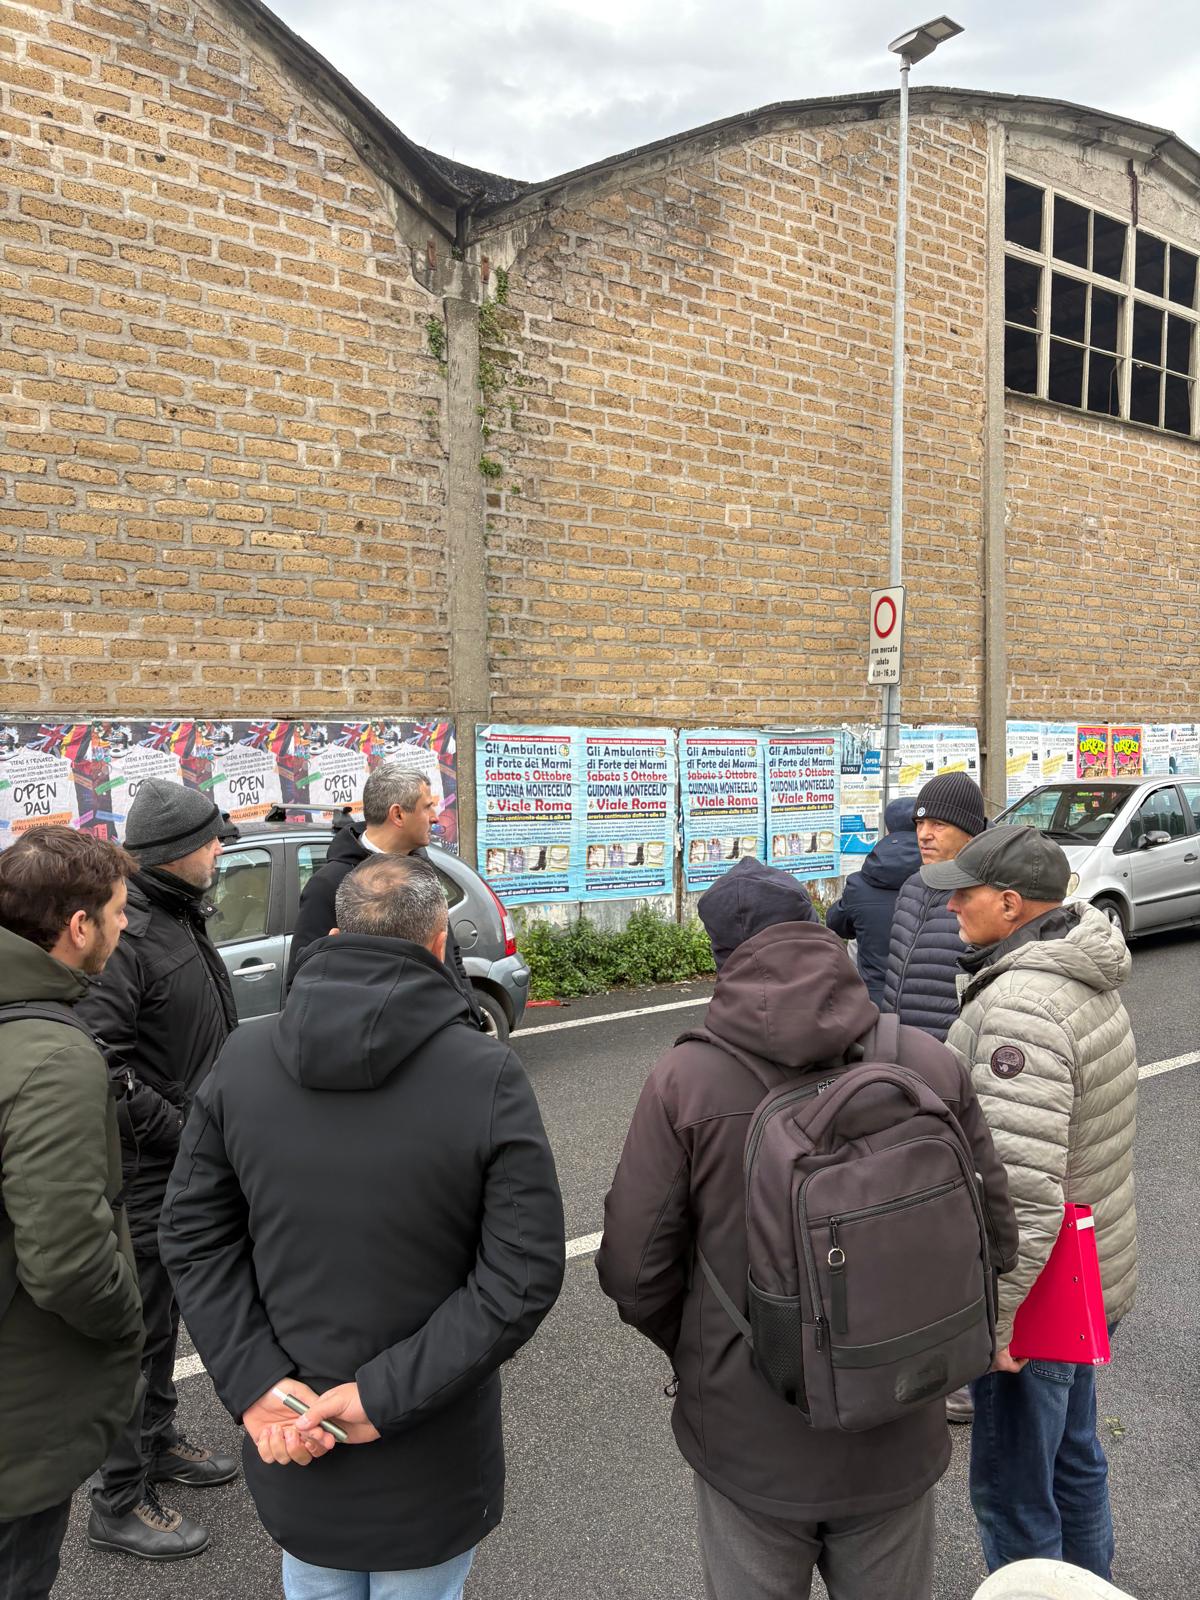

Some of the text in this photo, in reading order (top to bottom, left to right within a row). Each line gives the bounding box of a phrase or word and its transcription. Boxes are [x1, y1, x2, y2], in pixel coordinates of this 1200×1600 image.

[880, 645, 898, 653] mercato
[485, 743, 557, 755] Gli Ambulanti
[587, 746, 654, 756] Gli Ambulanti
[687, 747, 746, 756] Gli Ambulanti
[769, 746, 824, 755] Gli Ambulanti
[485, 757, 571, 768] di Forte dei Marmi
[587, 759, 667, 769] di Forte dei Marmi
[687, 759, 757, 768] di Forte dei Marmi
[769, 758, 834, 767] di Forte dei Marmi
[486, 770, 571, 781] Sabato 5 Ottobre
[587, 771, 667, 782] Sabato 5 Ottobre
[688, 770, 757, 780] Sabato 5 Ottobre
[769, 768, 796, 779] Sabato
[805, 768, 834, 777] Ottobre
[230, 775, 264, 793] OPEN
[324, 774, 356, 791] OPEN
[720, 782, 757, 793] MONTECELIO
[800, 779, 834, 791] MONTECELIO
[14, 782, 56, 802] OPEN
[332, 789, 352, 802] DAY
[526, 784, 571, 797] MONTECELIO
[587, 784, 667, 797] GUIDONIA MONTECELIO
[238, 791, 259, 805] DAY
[697, 795, 758, 808] Viale Roma
[778, 792, 834, 803] Viale Roma
[24, 800, 50, 816] DAY
[497, 799, 572, 811] Viale Roma
[597, 798, 666, 810] Viale Roma
